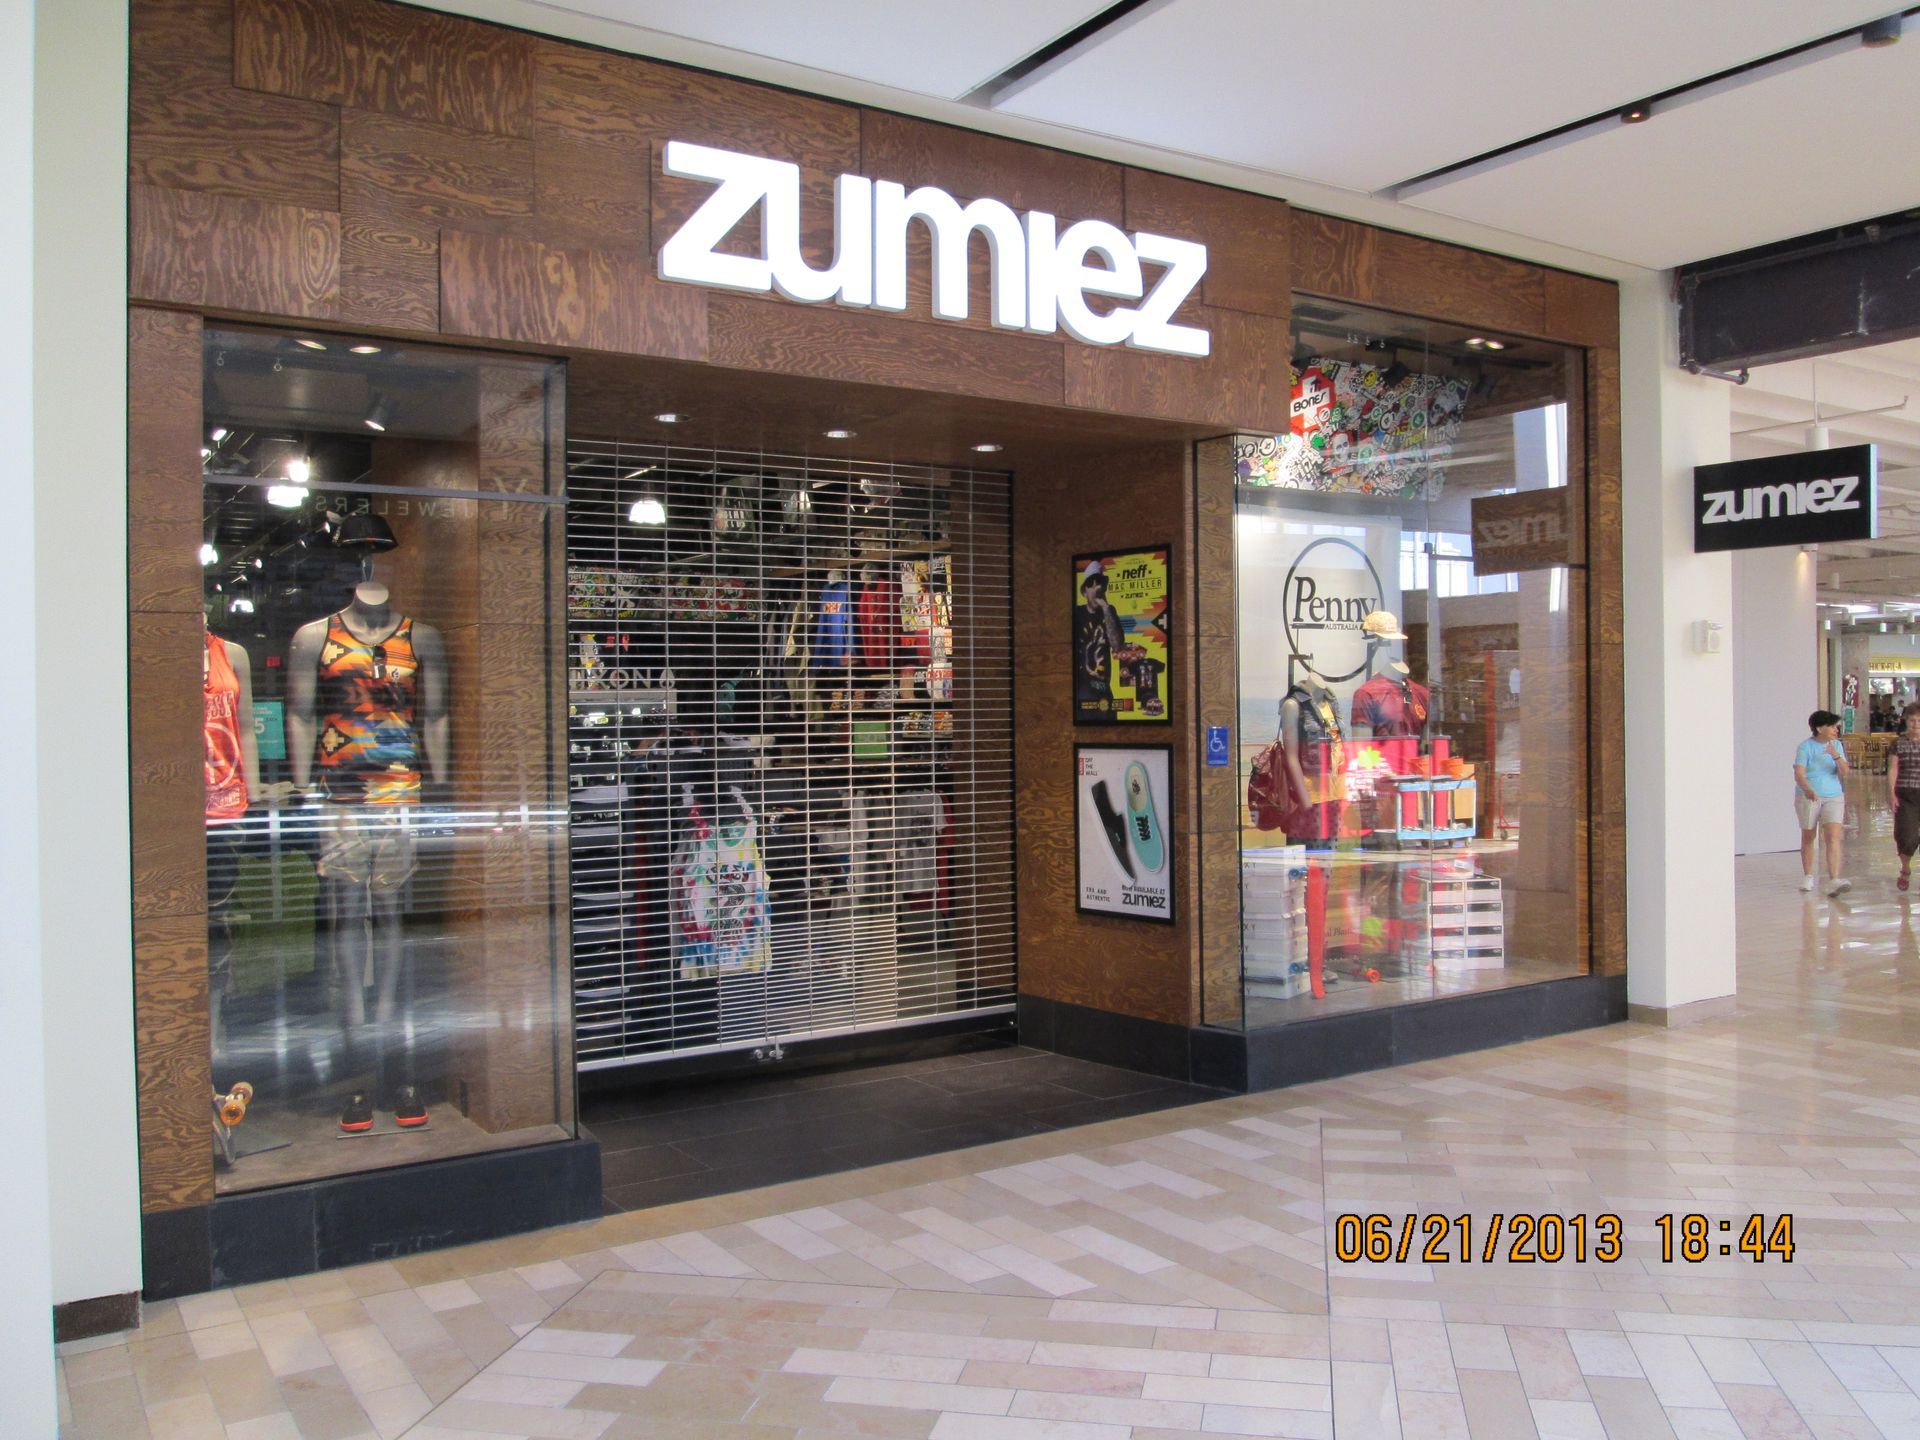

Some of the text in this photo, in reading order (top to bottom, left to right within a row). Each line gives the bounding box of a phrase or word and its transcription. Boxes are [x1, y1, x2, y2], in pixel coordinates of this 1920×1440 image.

[658, 140, 1211, 357] zumiez
[1293, 391, 1327, 412] BONES
[1702, 476, 1860, 524] zumiez
[1122, 564, 1148, 579] neff
[1129, 579, 1162, 589] MILLER
[1293, 576, 1378, 622] Penny
[1324, 623, 1359, 631] AUSTRALIA
[1122, 893, 1166, 909] zumiez
